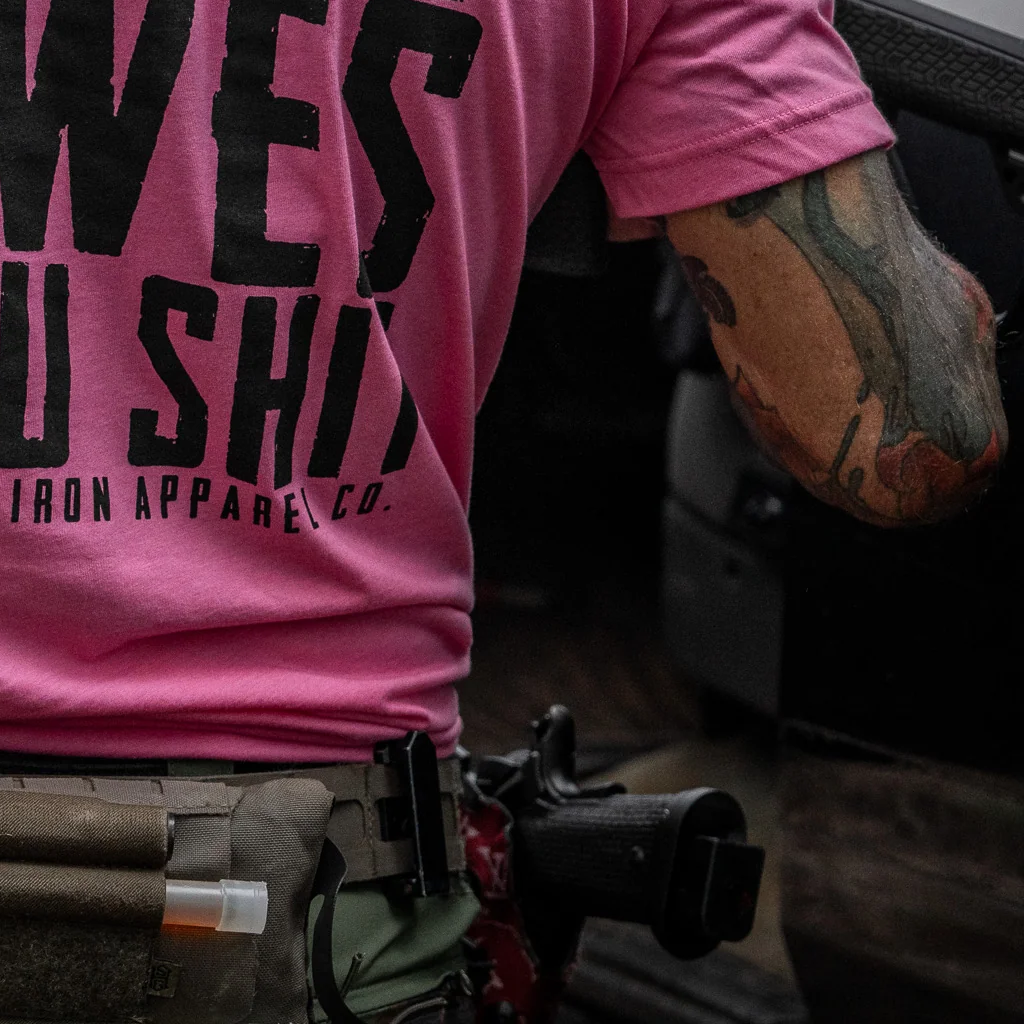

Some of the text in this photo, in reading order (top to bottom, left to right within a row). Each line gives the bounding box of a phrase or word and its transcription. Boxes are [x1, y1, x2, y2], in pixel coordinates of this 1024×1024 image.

[10, 476, 112, 524] IRON
[134, 474, 319, 533] APPAREL
[331, 482, 391, 521] CO.
